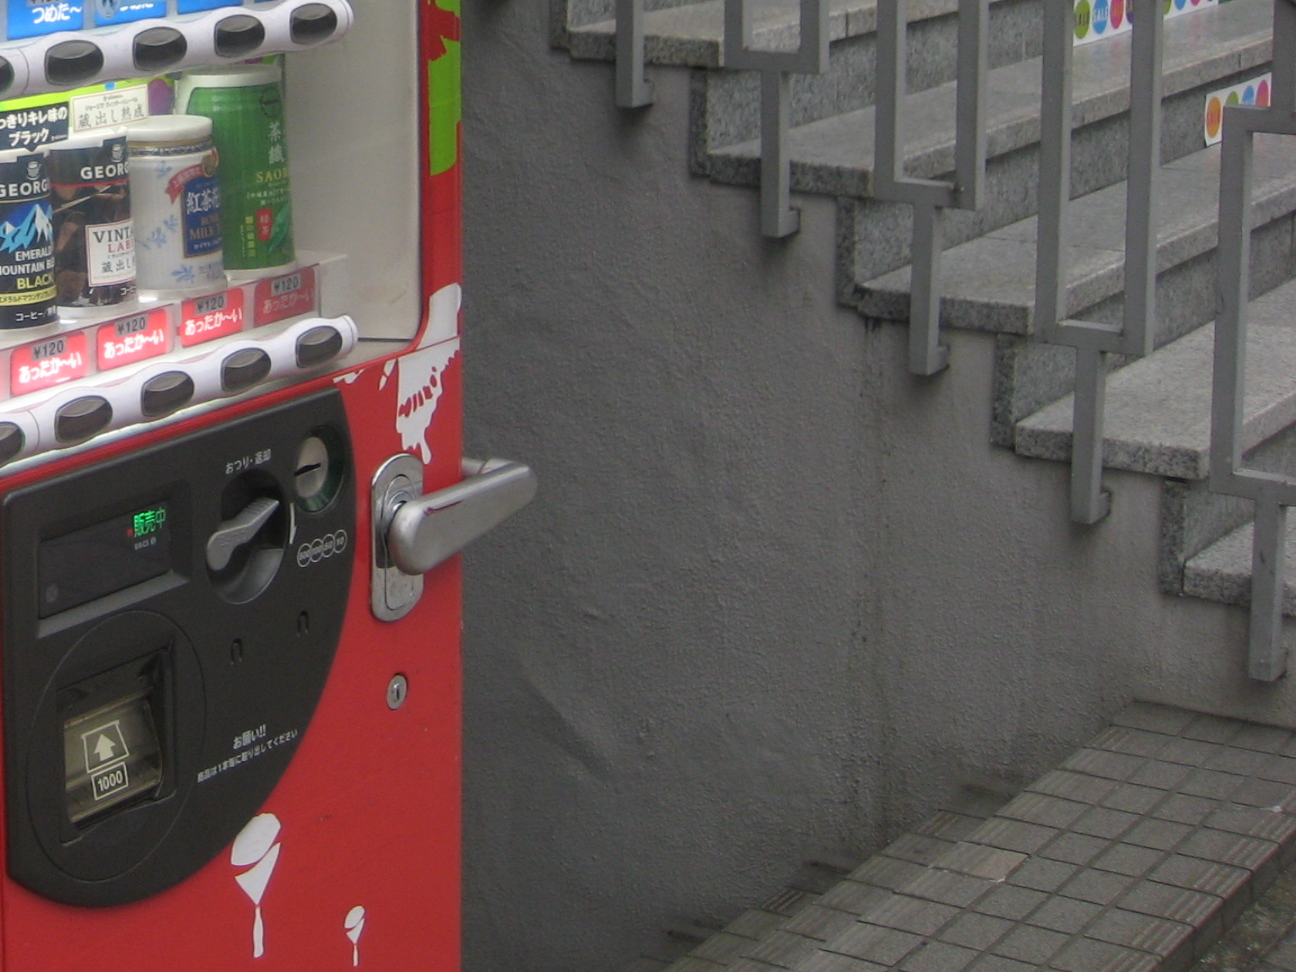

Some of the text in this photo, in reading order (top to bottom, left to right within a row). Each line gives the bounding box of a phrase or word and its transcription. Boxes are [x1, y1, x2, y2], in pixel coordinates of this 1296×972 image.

[1092, 5, 1109, 21] SALE
[197, 295, 224, 311] ¥120
[117, 317, 146, 334] ¥120
[33, 340, 64, 358] ¥120
[134, 508, 166, 537] 販売中
[97, 771, 125, 791] 1000
